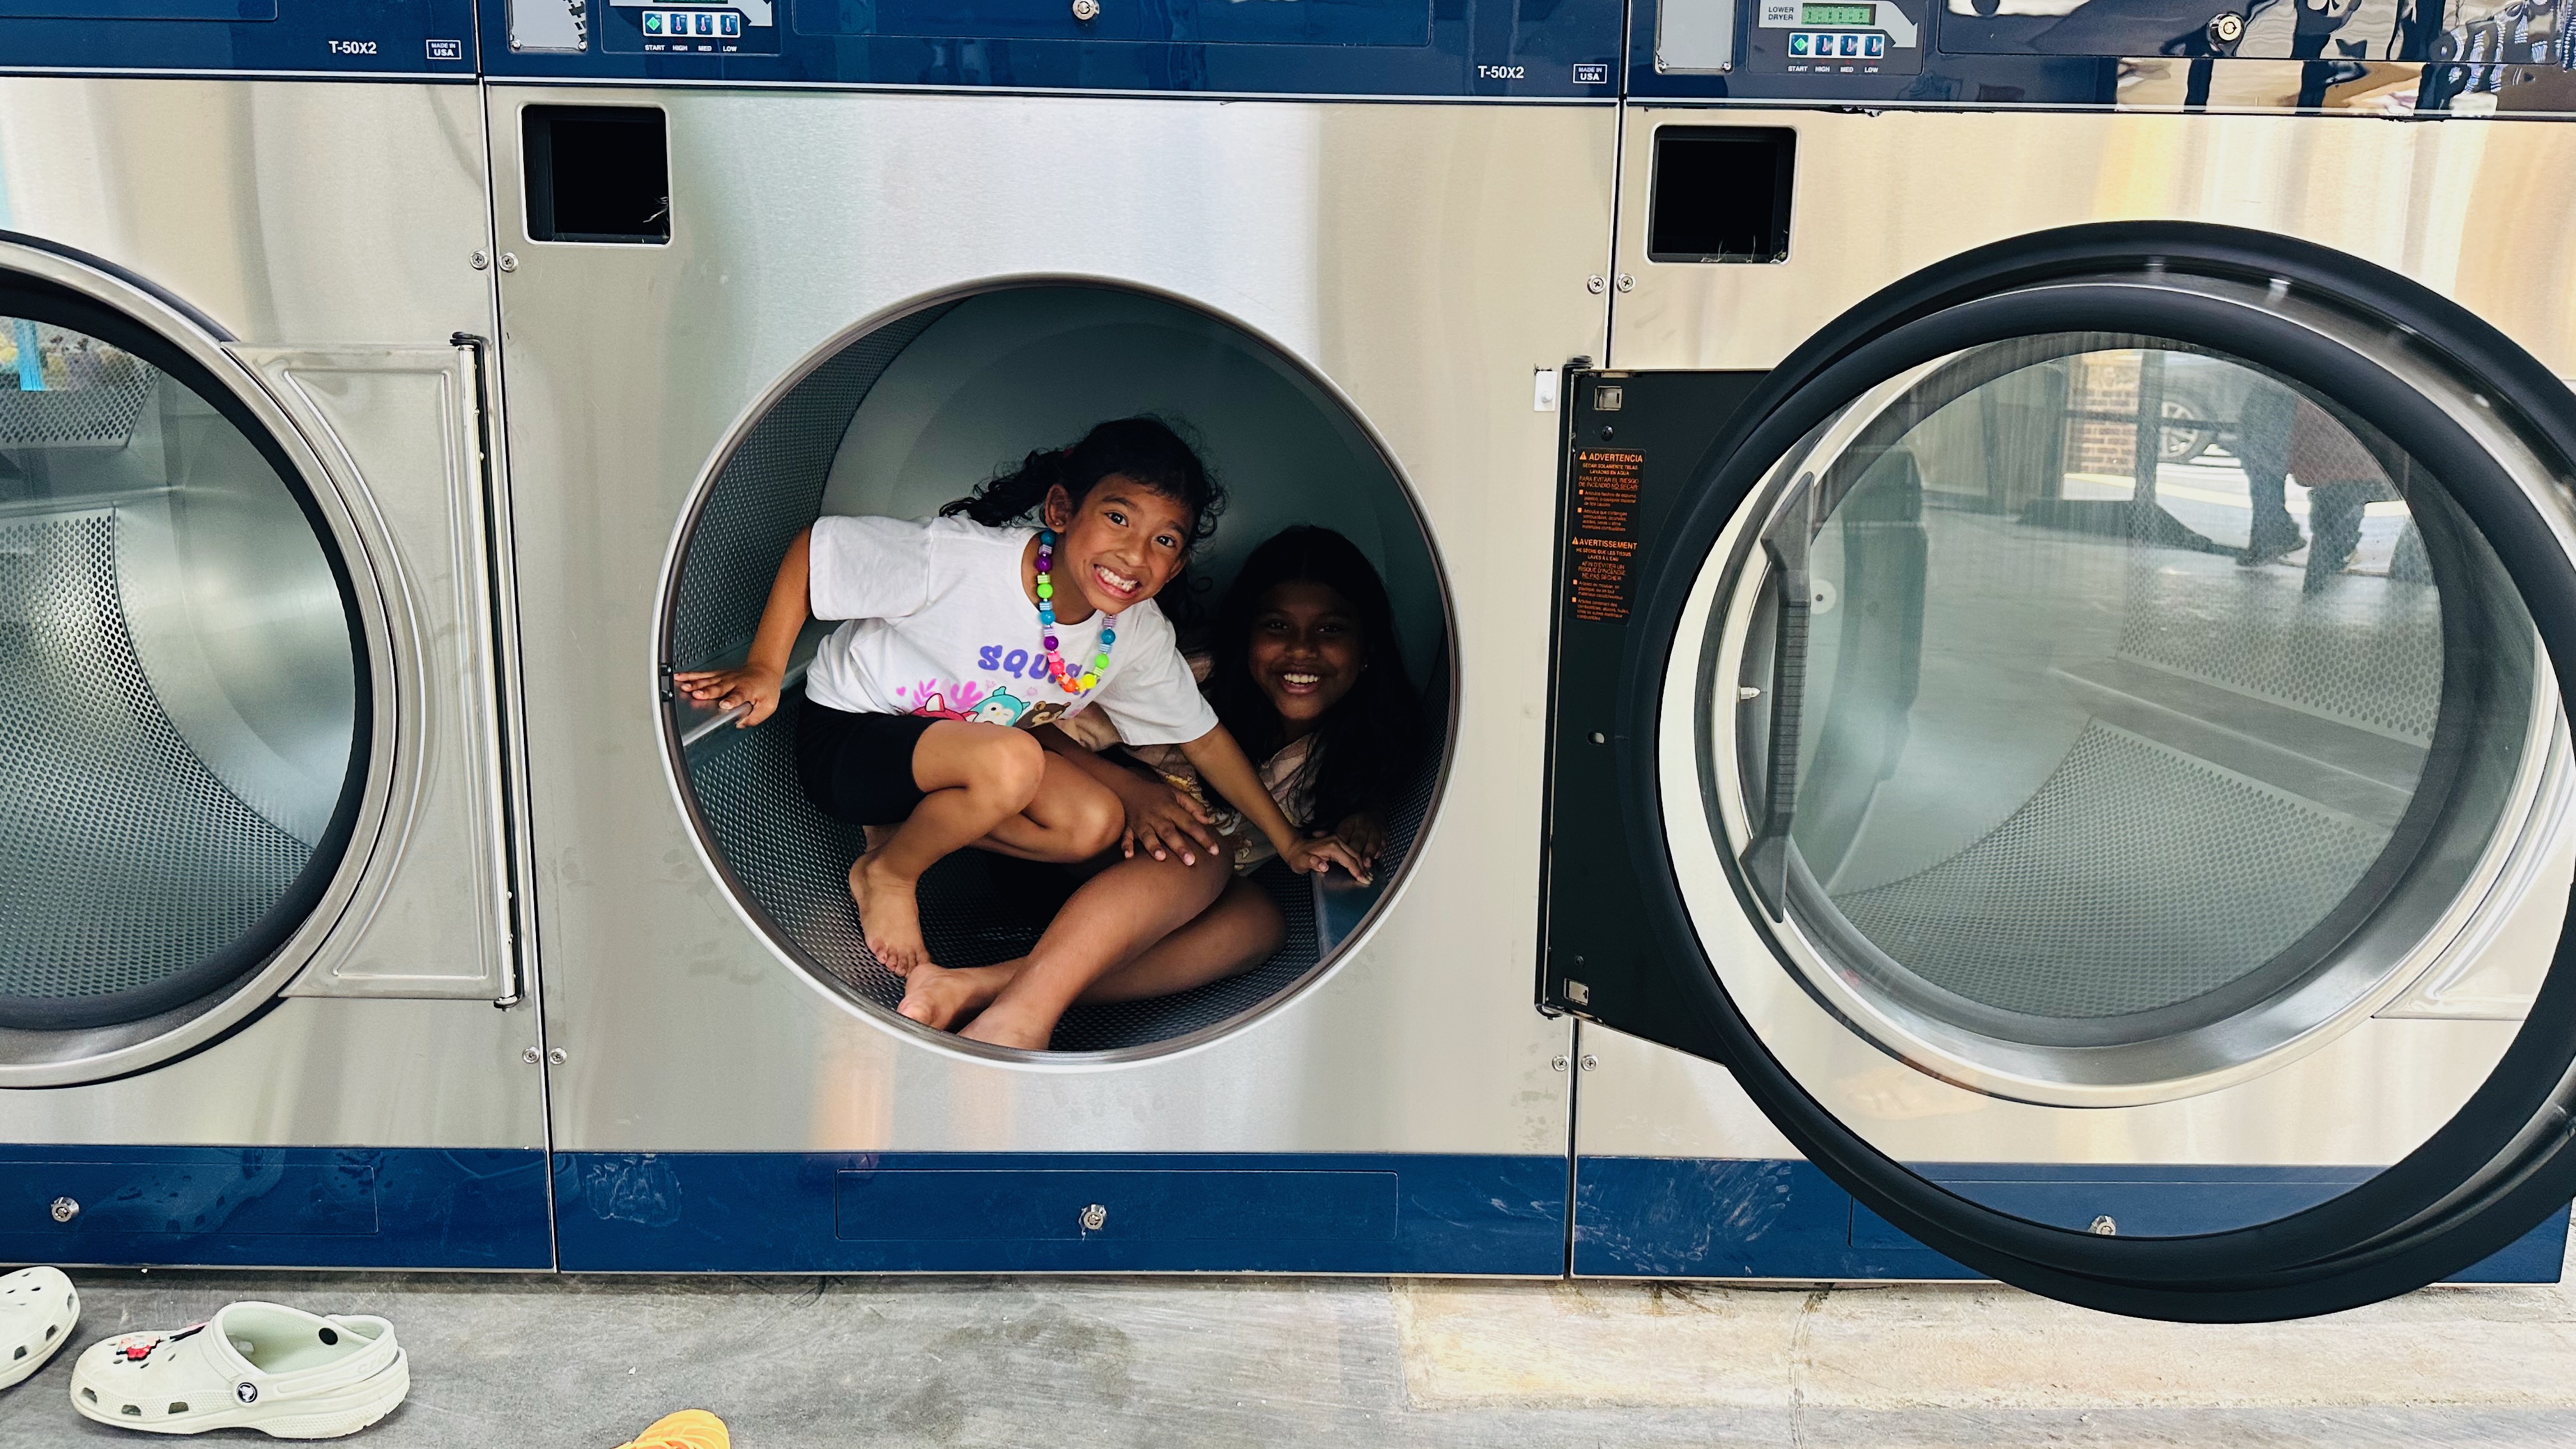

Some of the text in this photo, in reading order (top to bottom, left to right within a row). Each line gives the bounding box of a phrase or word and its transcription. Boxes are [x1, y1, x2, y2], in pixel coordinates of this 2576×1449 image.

[328, 40, 377, 54] T-50X2
[1477, 65, 1524, 79] T-50X2
[1589, 453, 1643, 463] ADVERTENCIA
[1579, 538, 1637, 549] AVERTISSEMENT
[977, 645, 1100, 698] SQU
